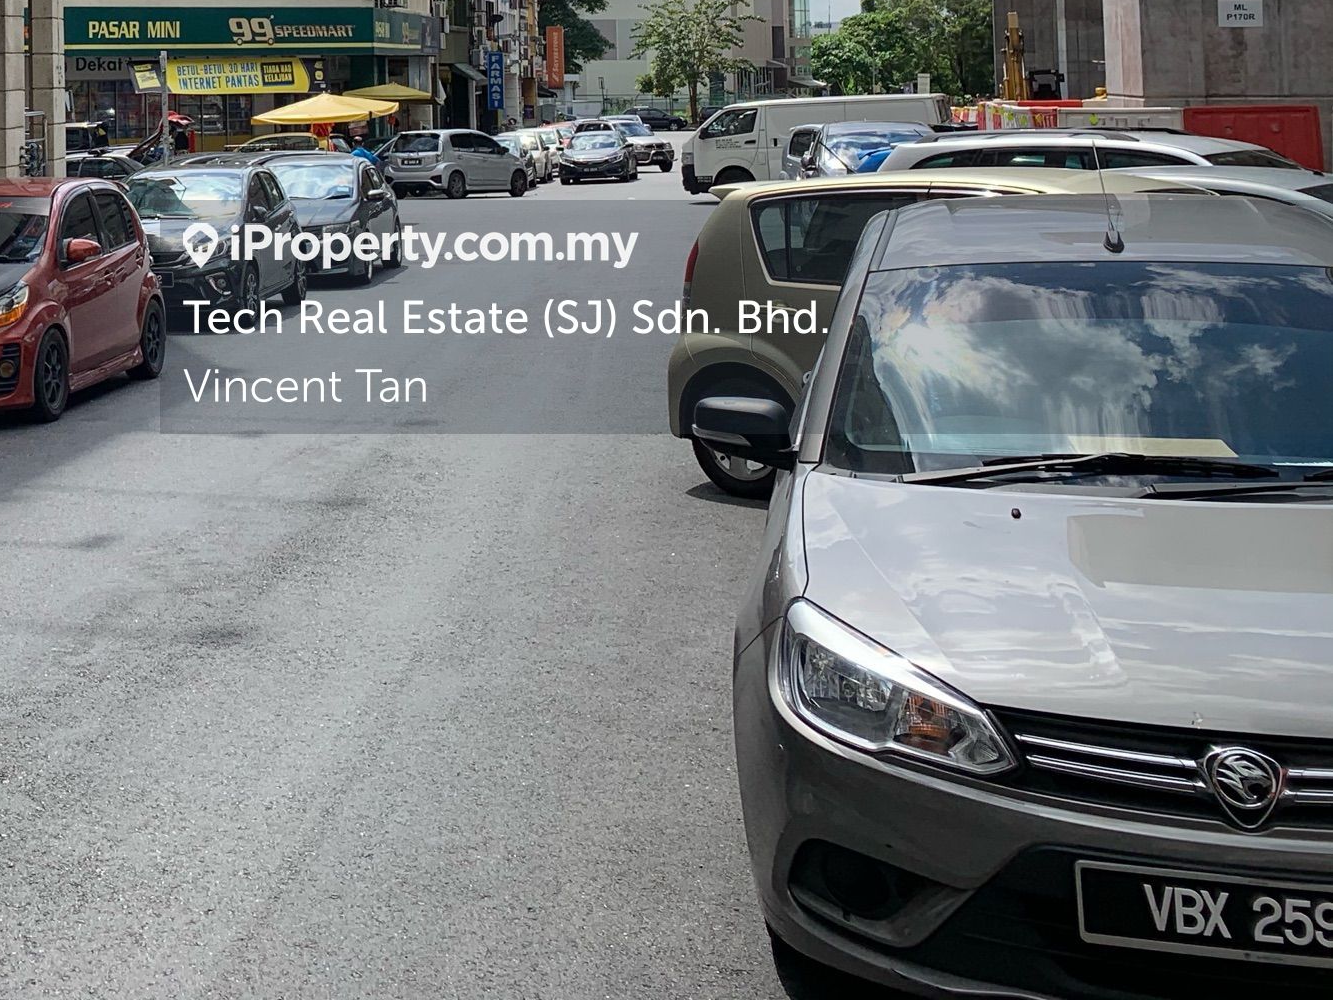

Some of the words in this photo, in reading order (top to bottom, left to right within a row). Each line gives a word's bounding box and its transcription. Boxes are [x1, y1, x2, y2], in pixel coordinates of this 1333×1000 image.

[1226, 13, 1256, 21] P170R
[88, 21, 140, 39] PASAR
[147, 21, 180, 39] MINI
[228, 16, 275, 46] 99
[274, 24, 355, 38] SPEEDMART
[75, 57, 124, 72] Dekat
[177, 63, 227, 77] BETUL-BETUL
[240, 62, 258, 73] HARI
[178, 76, 222, 90] INTERNET
[226, 74, 260, 88] PANTAS
[490, 56, 501, 108] FARMASI
[1143, 883, 1233, 939] VBX
[1252, 896, 1333, 949] 259
